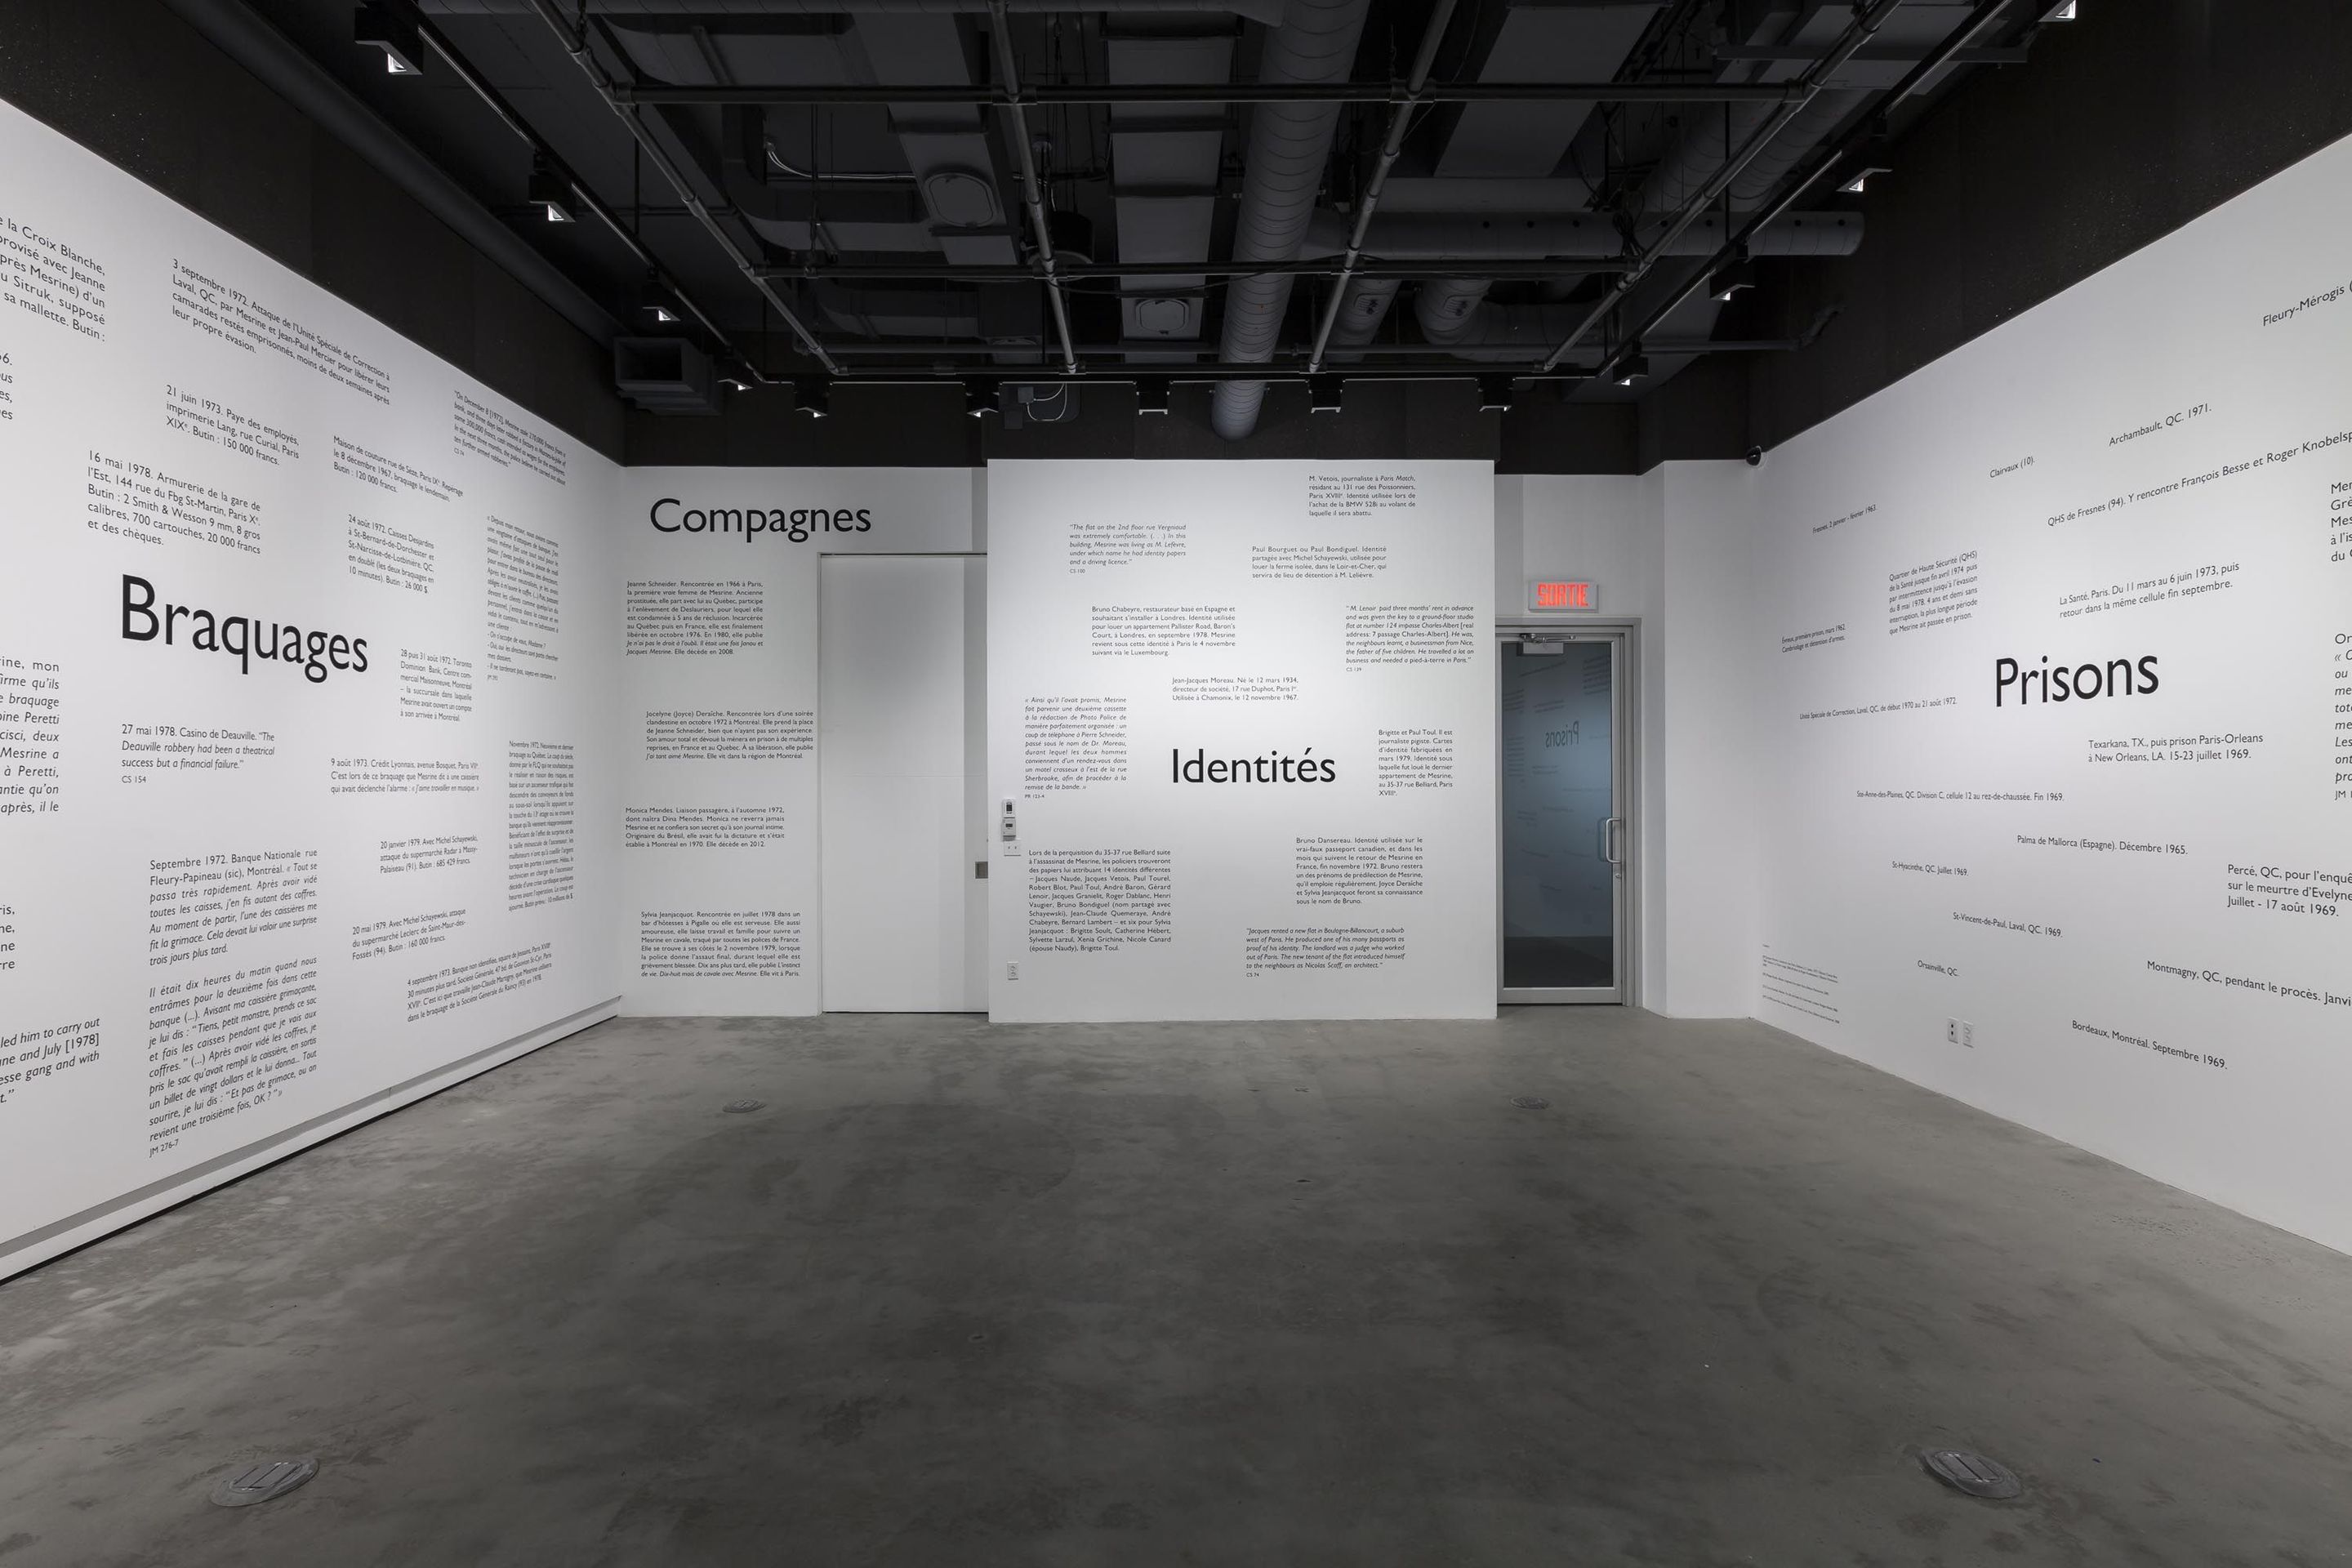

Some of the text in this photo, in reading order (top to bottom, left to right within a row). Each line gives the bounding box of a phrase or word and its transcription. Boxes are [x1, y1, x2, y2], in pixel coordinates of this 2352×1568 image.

[8, 218, 105, 276] la Croix Blanche,
[172, 258, 390, 381] 3 septembre 1972. Attaque de l'Unité Spéciale de Correction à
[2263, 286, 2345, 327] Fleury-Mérogis
[167, 385, 299, 446] 21 juin 1973. Paye des employés,
[2109, 403, 2212, 447] Archambault, QC. 1971.
[1341, 475, 1374, 483] journaliste
[1989, 456, 2035, 478] Clairvaux (10).
[90, 450, 261, 511] 16 mai 1978. Armurerie de la gare de
[2047, 448, 2299, 527] QHS de Fresnes (94). Y rencontre François Besse et Roger
[87, 520, 164, 546] et des chèques.
[348, 514, 434, 549] 24 août 1972. Caisses Desjardins
[650, 498, 871, 543] Compagnes
[1326, 546, 1359, 555] Bondiguel.
[1361, 546, 1387, 554] Identité
[626, 581, 647, 589] Jeanne
[648, 581, 679, 589] Schneider.
[1537, 582, 1588, 607] SORTIE
[2060, 562, 2239, 605] La Santé, Paris. Du 11 mars au 6 juin 1973, puis
[122, 573, 368, 684] Braquages
[1171, 677, 1209, 685] Jean-Jacques
[1996, 655, 2159, 707] Prisons
[9, 693, 60, 710] braquage
[24, 711, 60, 724] Peretti
[122, 724, 133, 734] 27
[136, 726, 152, 735] mai
[155, 726, 177, 737] 1978.
[180, 727, 207, 738] Casino
[209, 729, 219, 739] de
[221, 729, 257, 741] Deauville.
[2088, 740, 2129, 749] Texarkana,
[2150, 738, 2167, 749] puis
[2169, 737, 2197, 748] prison
[2199, 733, 2264, 745] Paris-Orleans
[1173, 747, 1336, 783] Identités
[121, 775, 146, 783] CS 154
[2017, 835, 2188, 854] Palma de Mallorca (Espagne). Décembre 1965.
[150, 858, 201, 872] Septembre
[206, 854, 228, 866] 1972.
[231, 853, 261, 864] Banque
[264, 849, 301, 861] Nationale
[1892, 861, 1924, 872] St-Hyacinthe,
[1937, 866, 1953, 875] Juillet
[1954, 867, 1968, 876] 1969.
[2228, 864, 2311, 882] Percé, QC, pour
[1953, 911, 2007, 929] St-Vincent-de-Paul,
[2009, 921, 2026, 933] Laval,
[2045, 927, 2063, 938] 1969.
[1918, 960, 1946, 974] Orsainville,
[2147, 960, 2320, 1004] Montmagny, QC, pendant le procès.
[2072, 1020, 2227, 1070] Bordeaux, Montréal. Septembre 1969.
